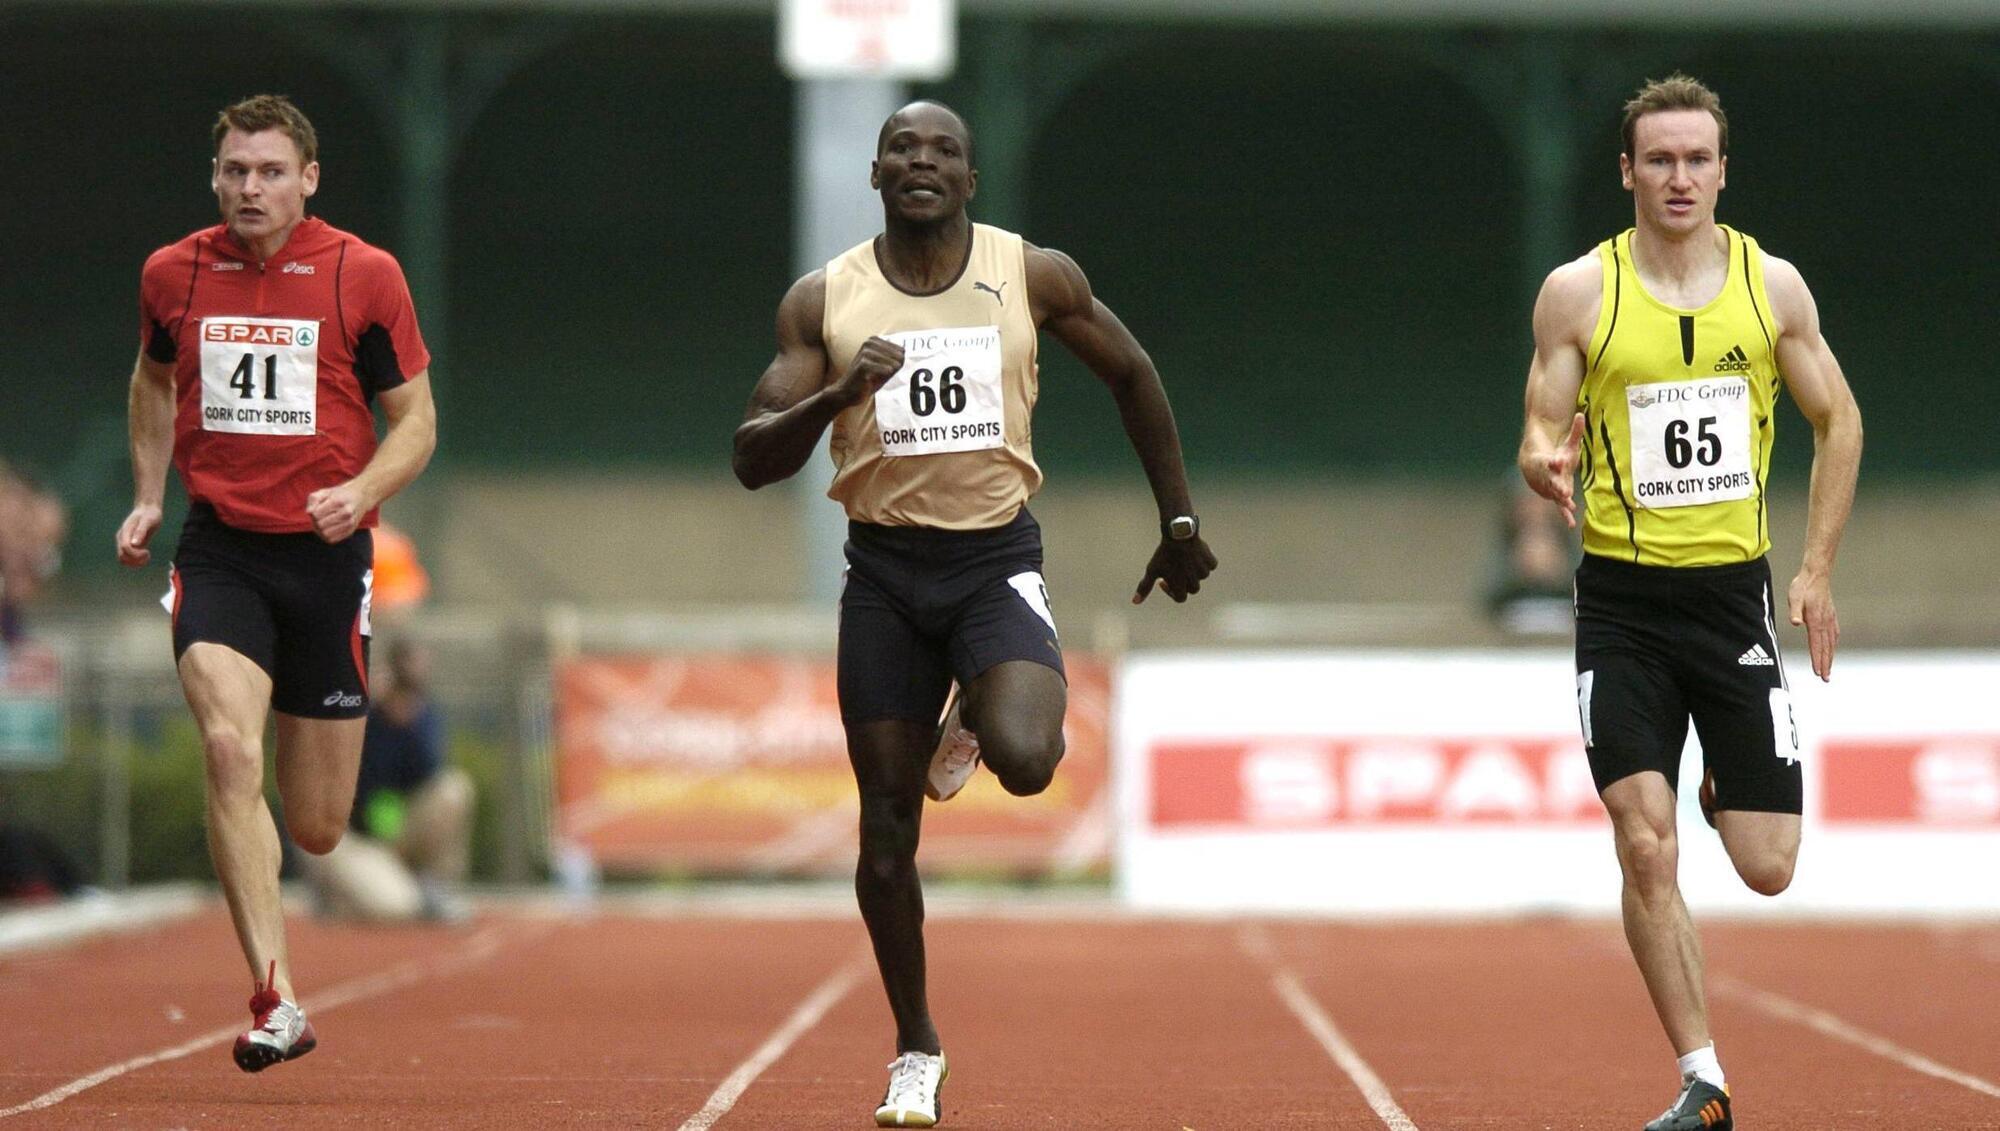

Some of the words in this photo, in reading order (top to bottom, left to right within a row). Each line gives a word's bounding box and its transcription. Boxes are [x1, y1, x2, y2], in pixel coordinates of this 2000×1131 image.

[207, 325, 292, 344] SPAR
[230, 353, 277, 400] 41
[1714, 361, 1751, 372] adidas
[909, 365, 967, 417] 66
[1657, 386, 1693, 403] FDC
[1698, 384, 1746, 401] Group
[205, 406, 234, 421] CORK
[237, 408, 262, 423] CITY
[265, 409, 312, 424] SPORTS
[883, 428, 917, 445] CORK
[920, 425, 948, 442] CITY
[951, 421, 1000, 440] SPORTS
[1664, 416, 1722, 469] 65
[1638, 480, 1674, 497] CORK
[1678, 477, 1705, 494] CITY
[1708, 472, 1750, 491] SPORTS
[1738, 657, 1774, 665] adidas
